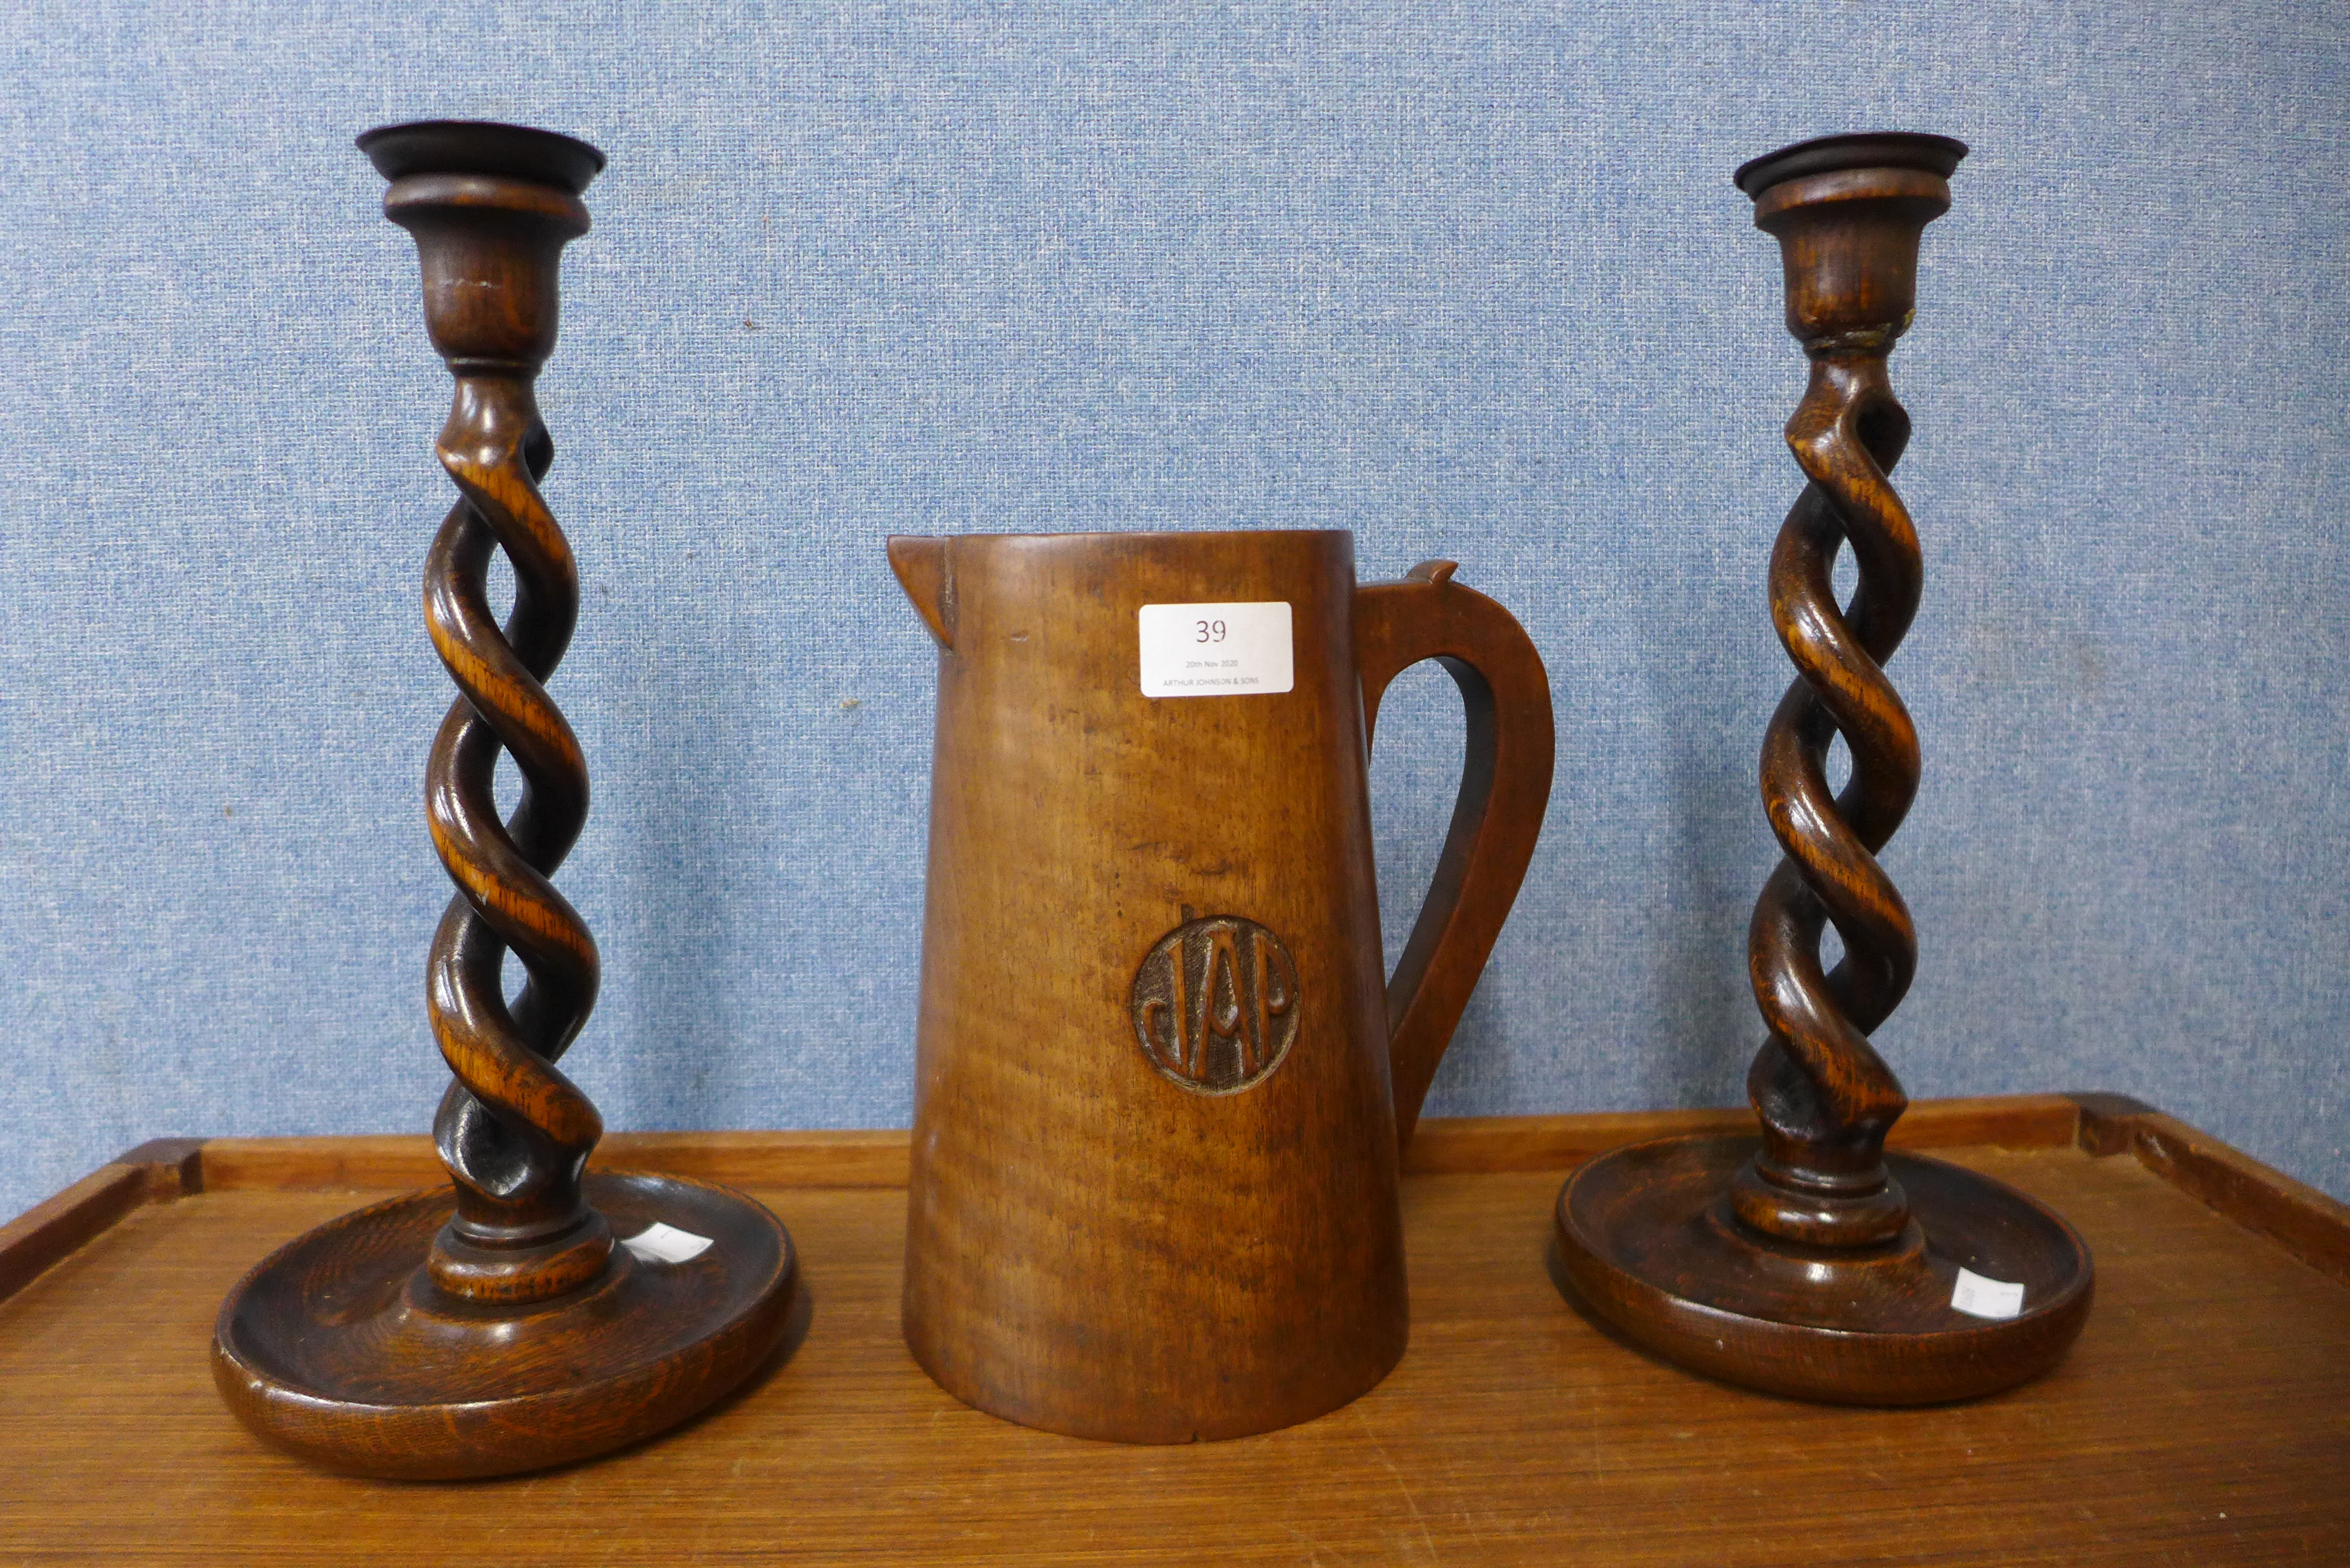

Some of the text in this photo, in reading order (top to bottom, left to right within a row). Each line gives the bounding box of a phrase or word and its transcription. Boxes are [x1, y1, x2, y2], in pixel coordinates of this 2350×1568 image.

[1196, 620, 1226, 643] 39
[1186, 660, 1202, 668] 20th
[1221, 660, 1238, 668] 2020
[1163, 679, 1194, 687] ARTHUR
[1196, 678, 1231, 686] JOHNSON
[1240, 676, 1259, 685] SONS
